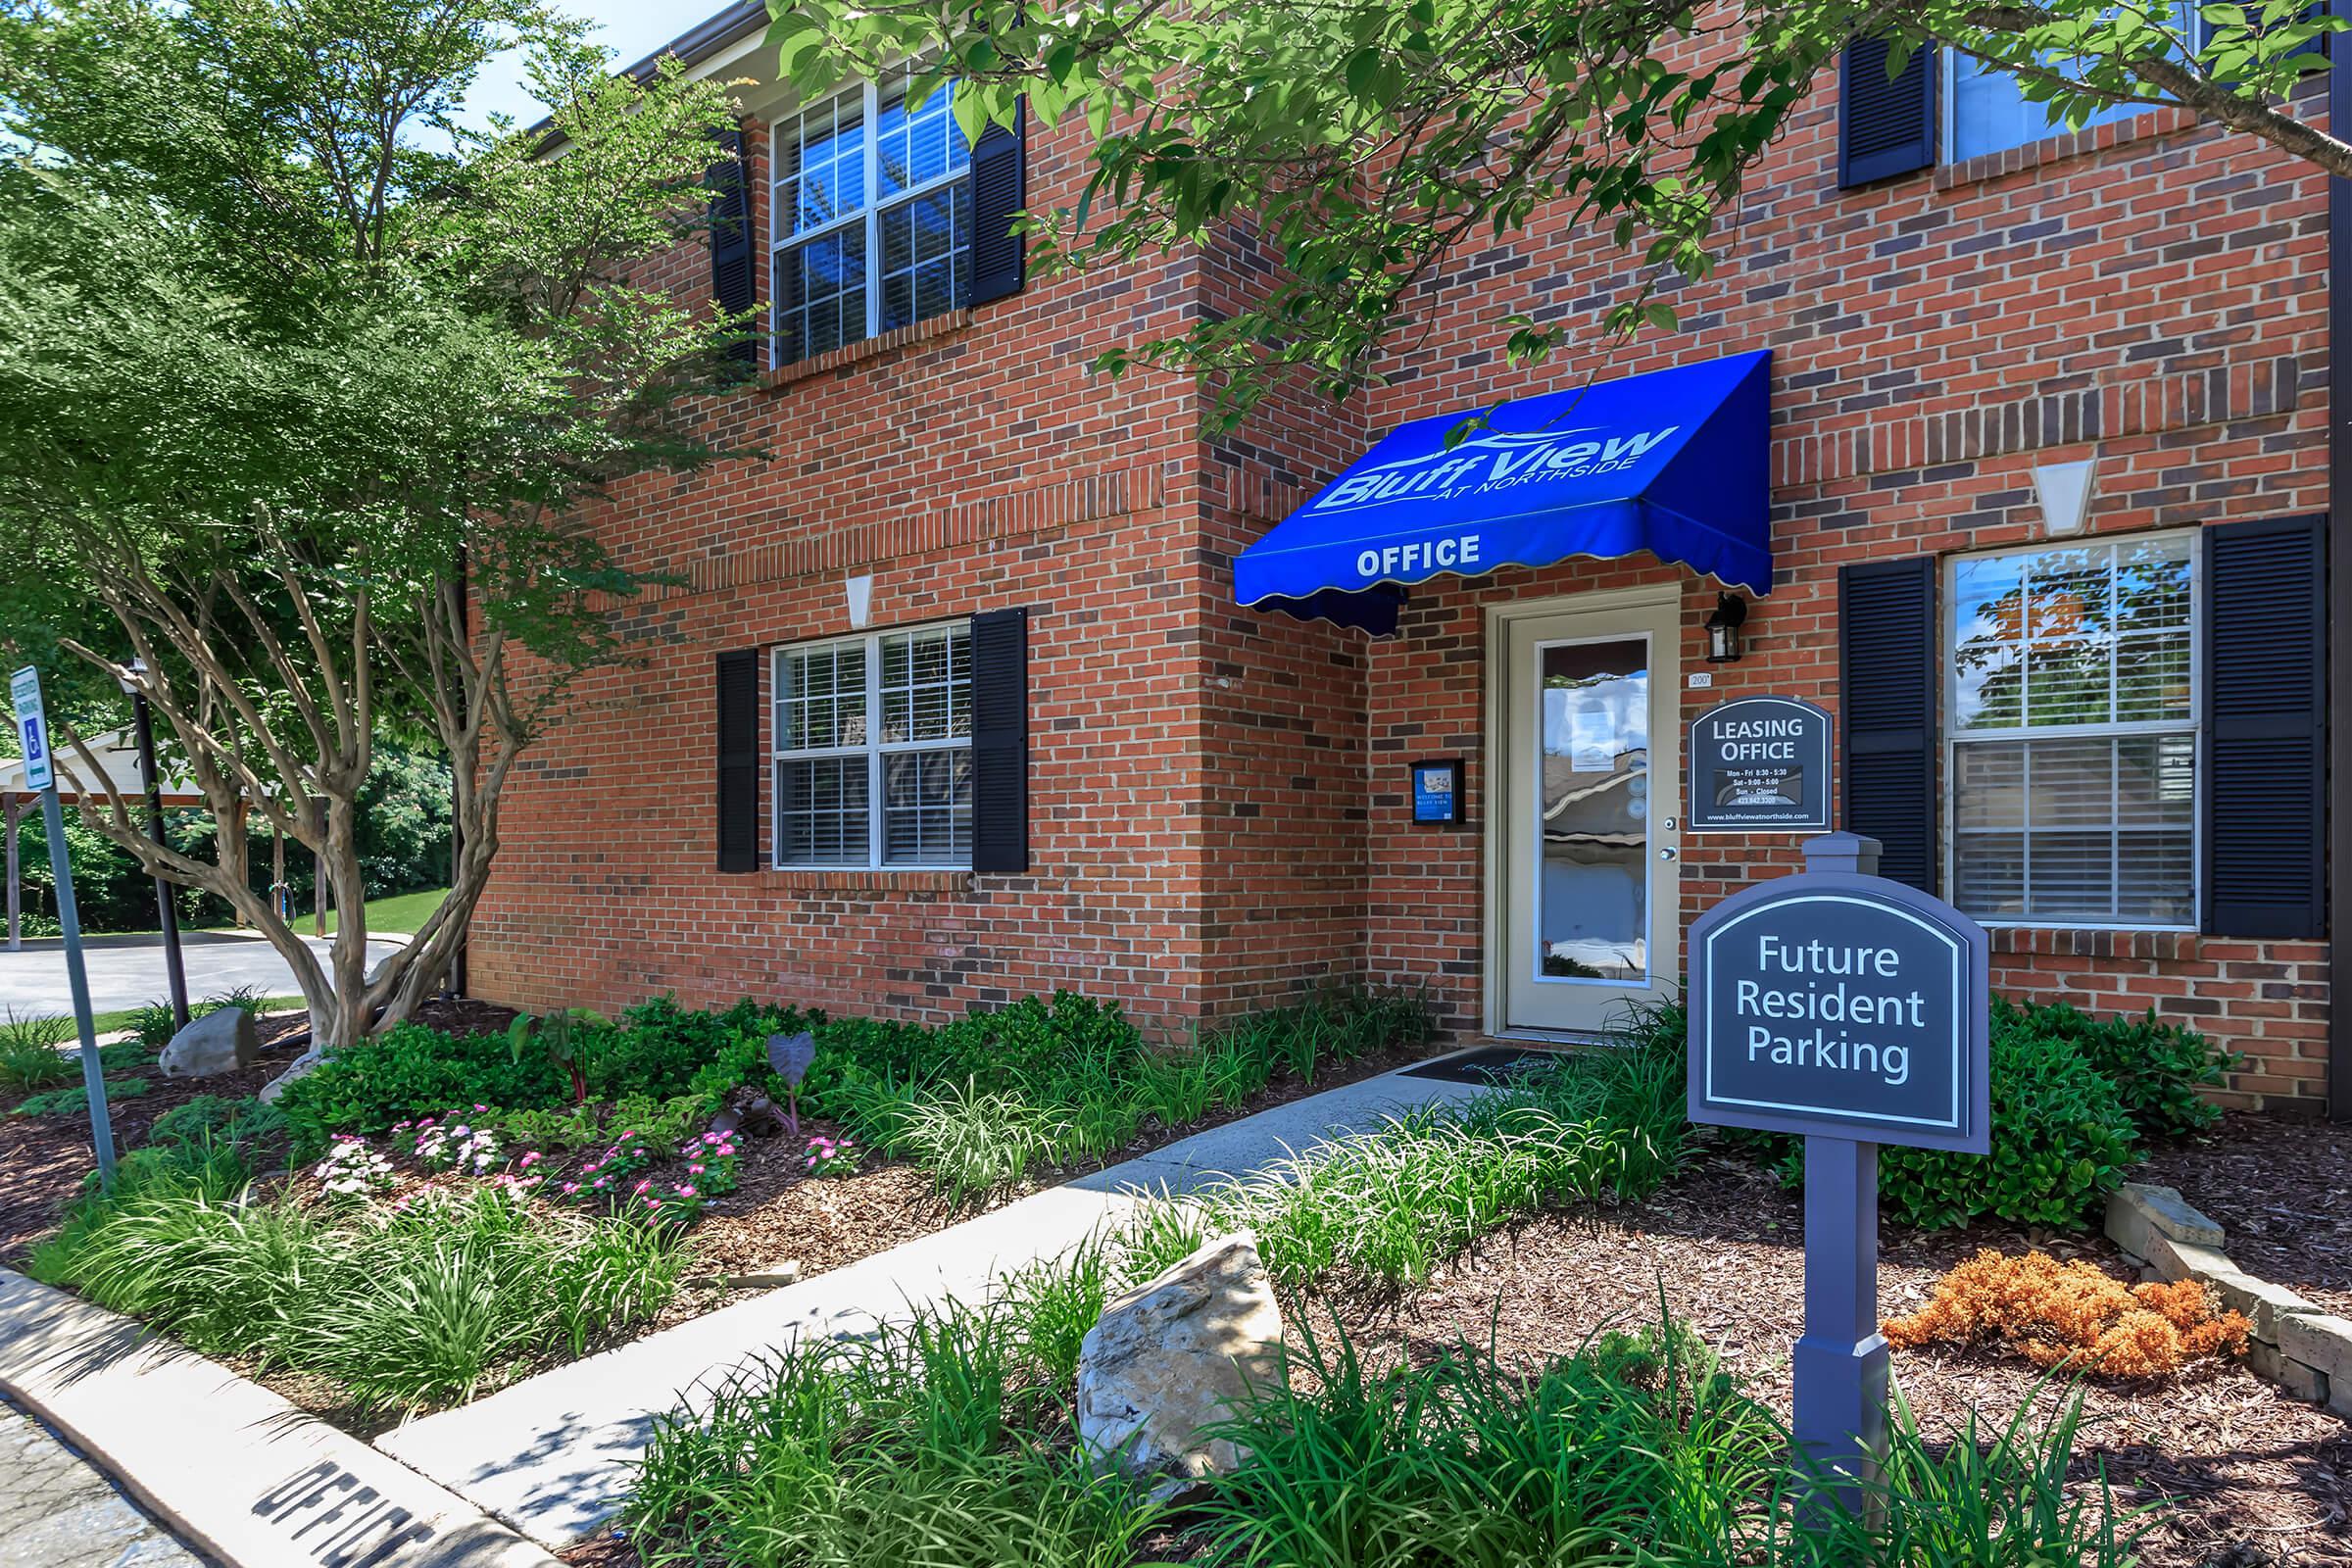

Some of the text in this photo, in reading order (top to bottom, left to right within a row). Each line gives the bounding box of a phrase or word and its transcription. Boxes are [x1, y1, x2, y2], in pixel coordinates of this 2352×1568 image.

[1313, 425, 1680, 509] Bluff View
[1433, 456, 1644, 502] AT NORTHSIDE
[1356, 534, 1481, 576] OFFICE
[1713, 718, 1803, 740] LEASING
[1721, 742, 1794, 760] OFFICE
[1759, 935, 1899, 977] Future
[1737, 980, 1925, 1027] Resident
[1748, 1026, 1909, 1085] Parking
